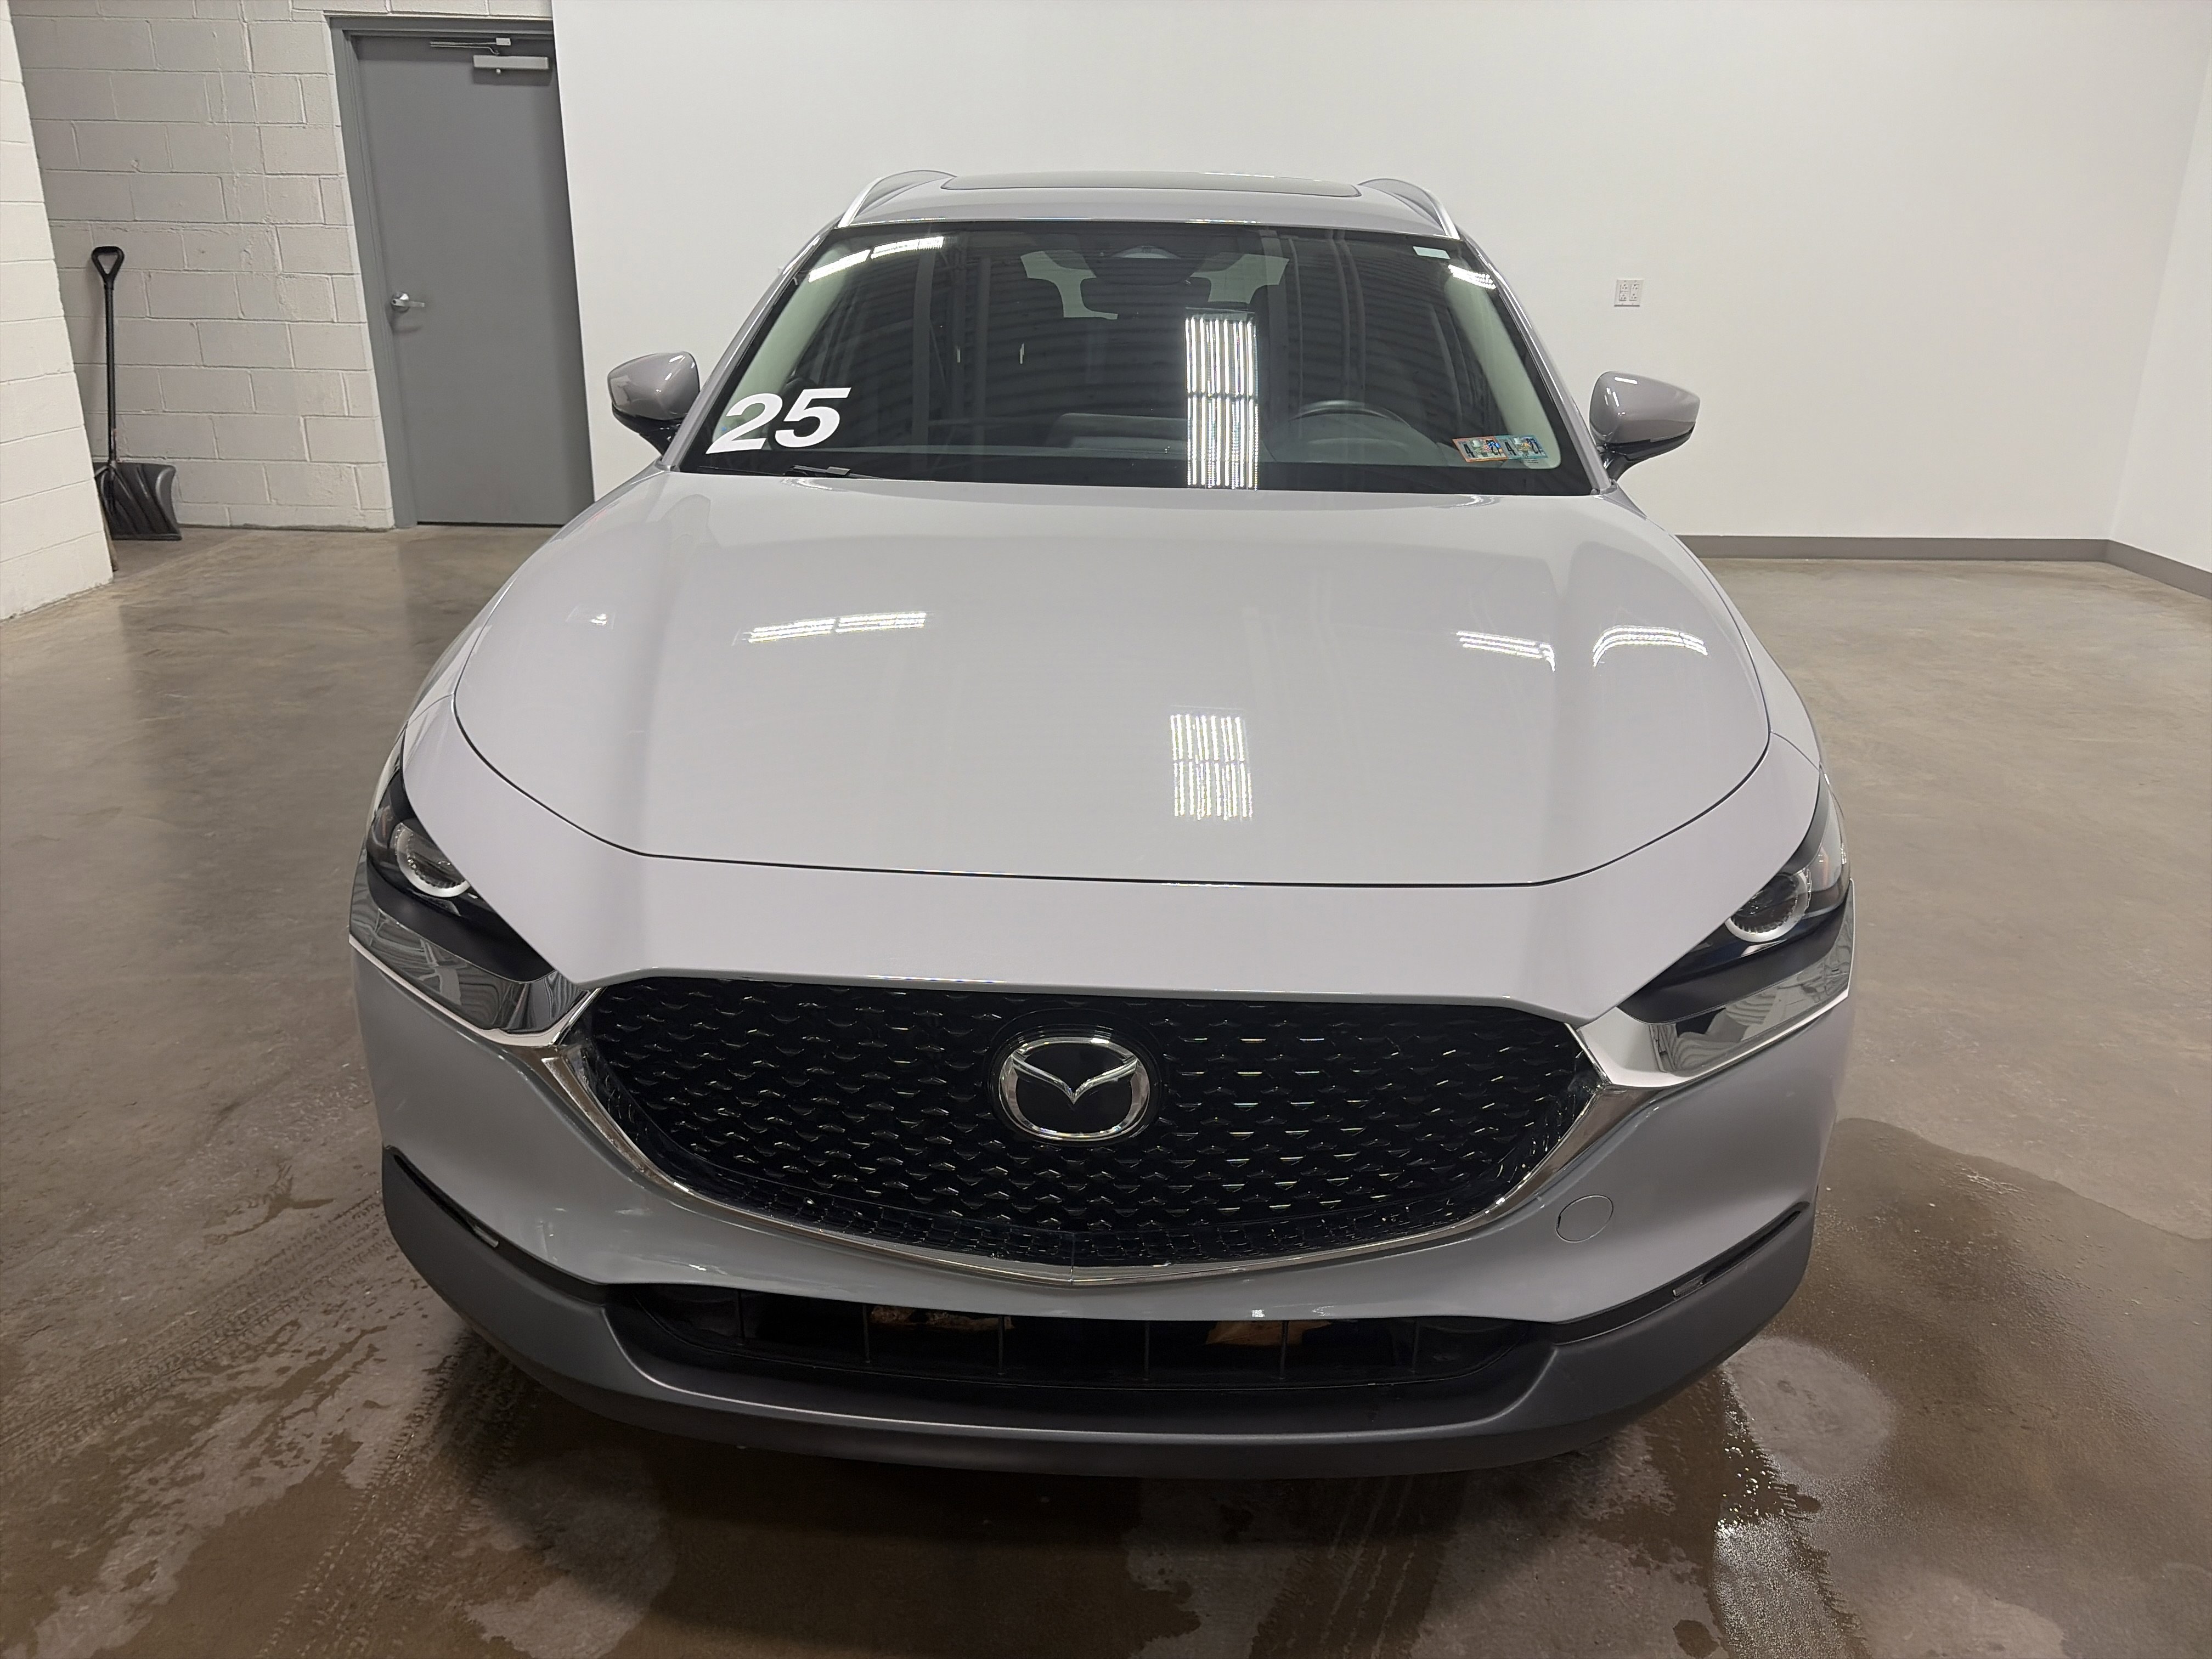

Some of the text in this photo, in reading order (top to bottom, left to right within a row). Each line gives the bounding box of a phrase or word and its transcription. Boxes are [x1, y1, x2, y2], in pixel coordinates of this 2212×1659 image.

[706, 387, 851, 454] 25
[1463, 444, 1475, 458] 4
[1504, 442, 1517, 455] 4
